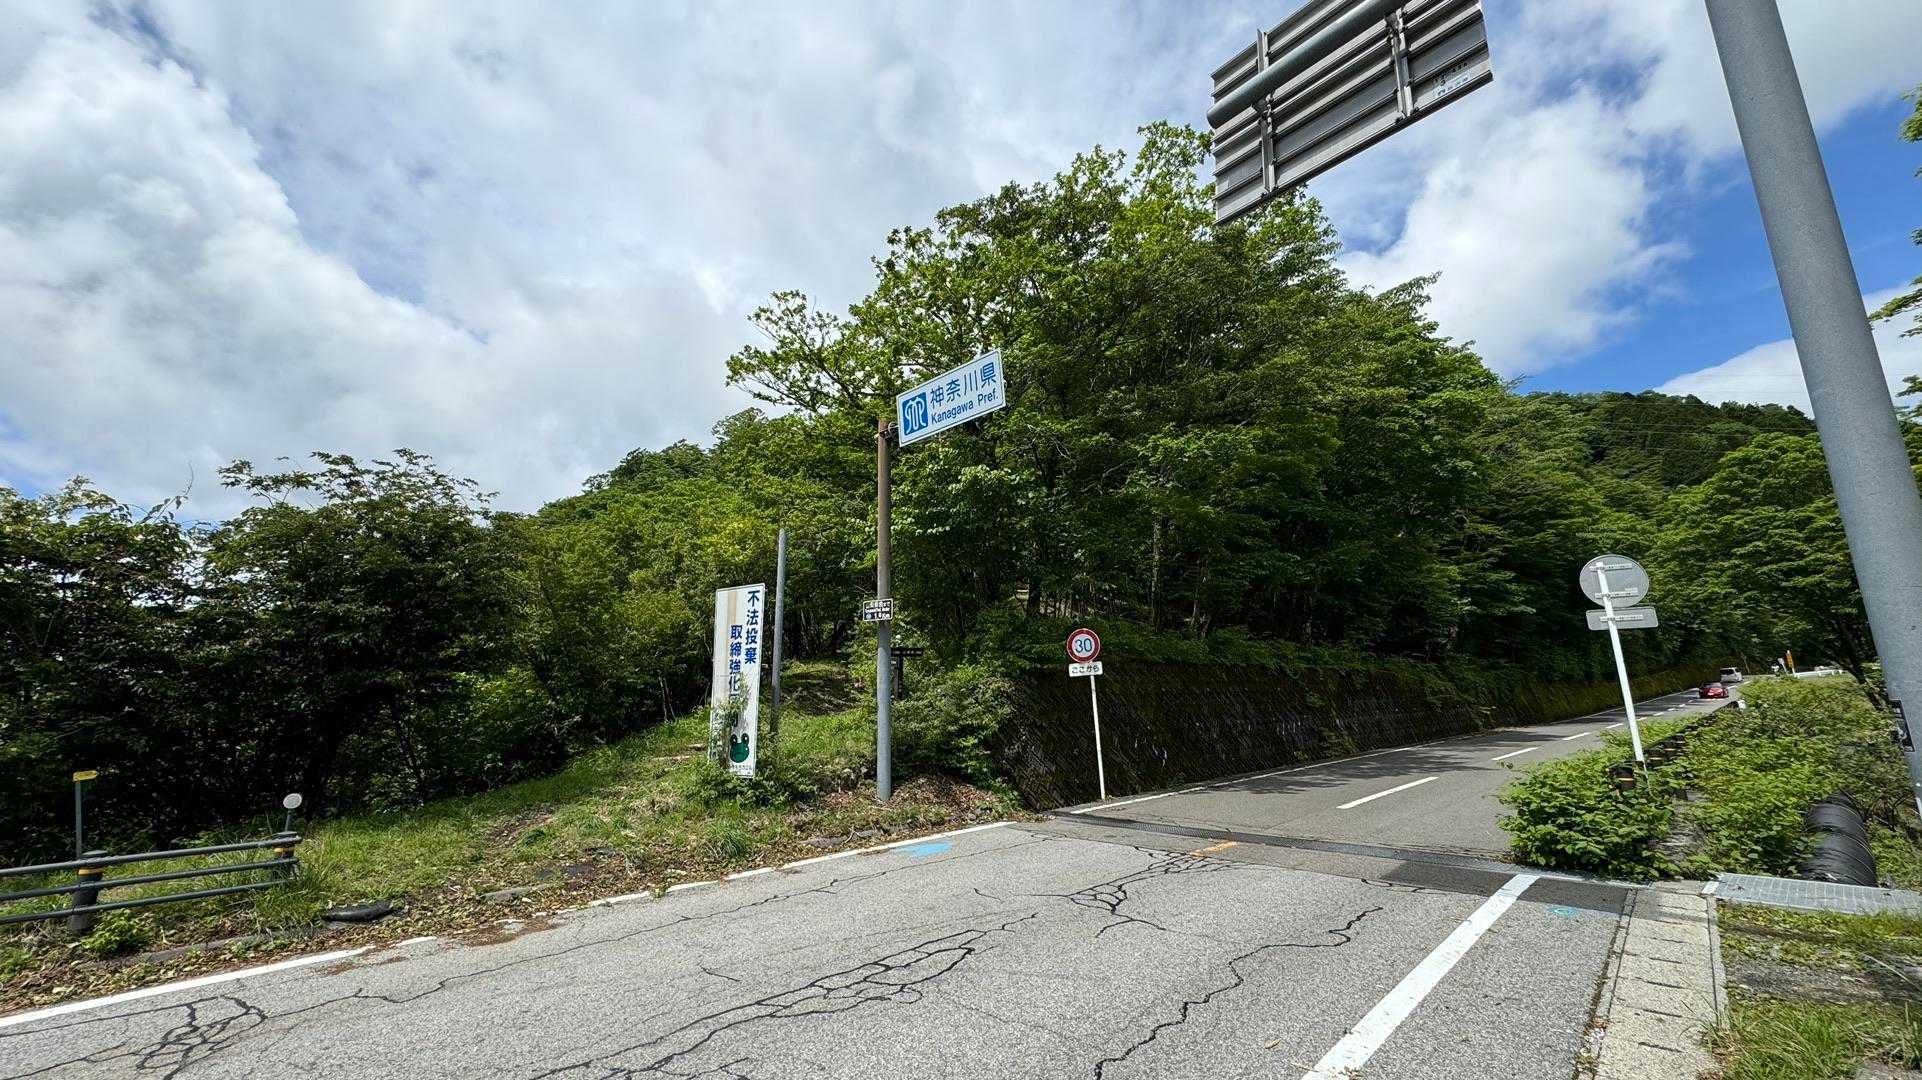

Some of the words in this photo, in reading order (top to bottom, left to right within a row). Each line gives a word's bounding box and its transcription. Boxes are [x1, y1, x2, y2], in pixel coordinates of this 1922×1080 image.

[930, 362, 997, 409] 神奈川県
[931, 400, 974, 425] Kanagawa
[977, 388, 999, 406] Pref.
[744, 589, 760, 665] 不法投棄
[1075, 638, 1092, 653] 30
[1071, 664, 1100, 674] ここから
